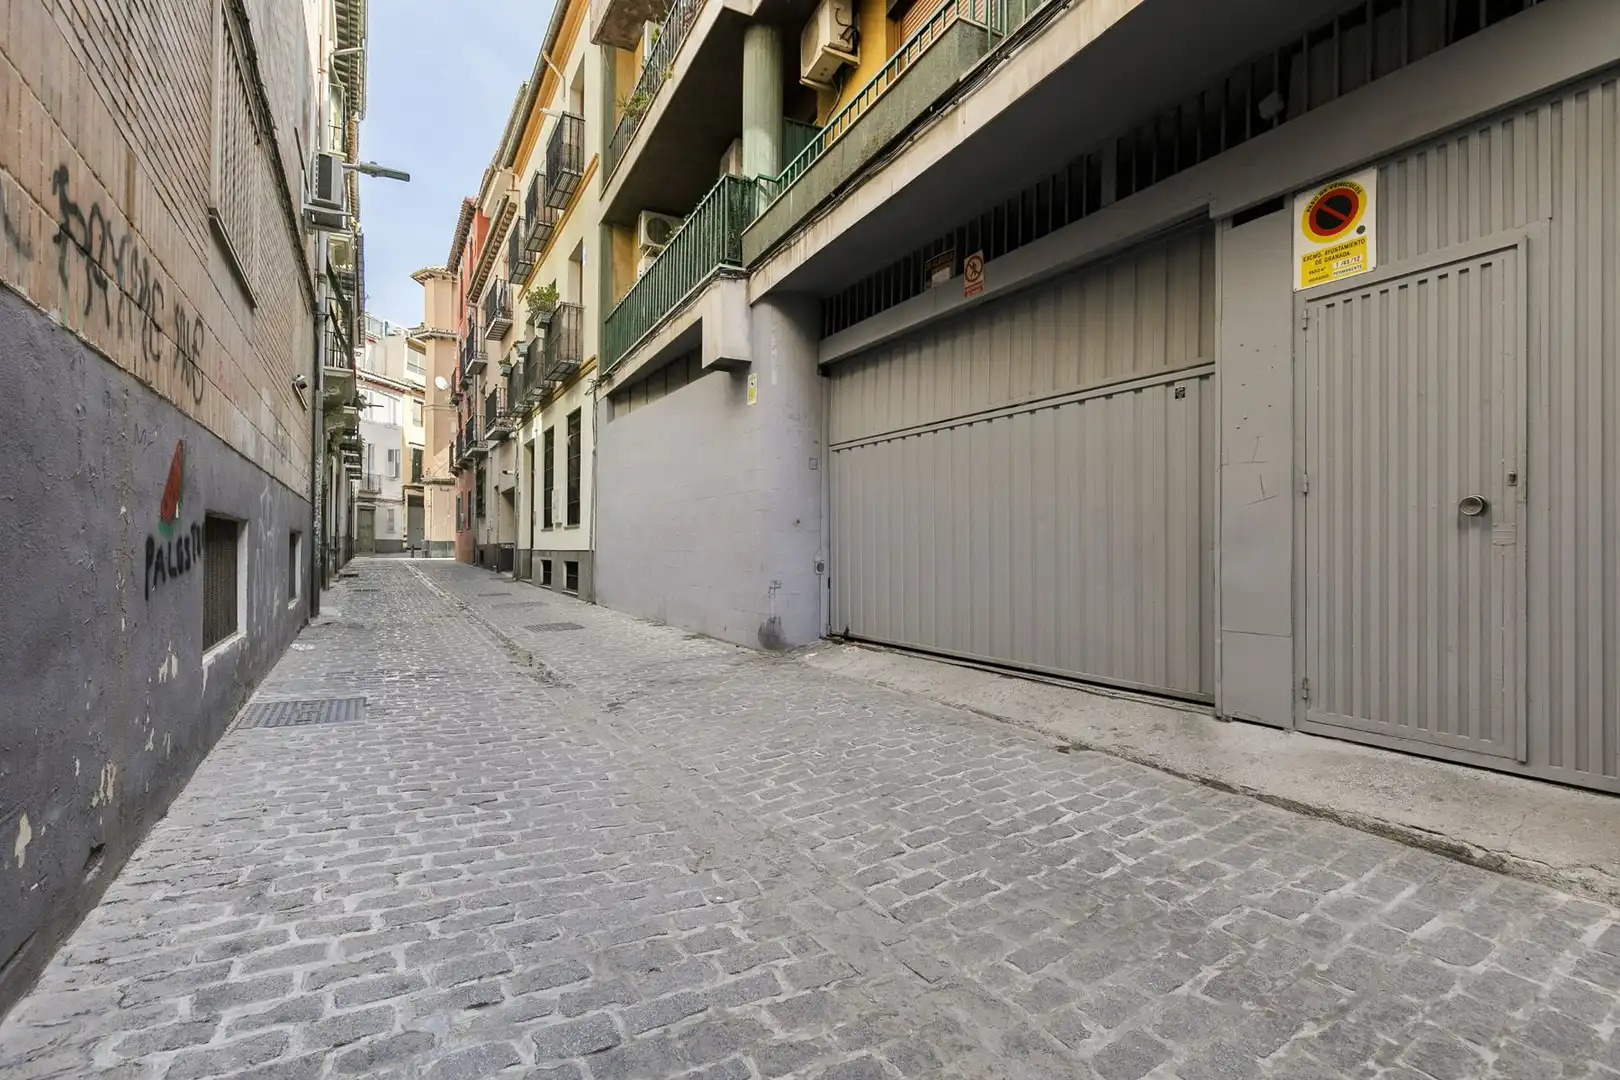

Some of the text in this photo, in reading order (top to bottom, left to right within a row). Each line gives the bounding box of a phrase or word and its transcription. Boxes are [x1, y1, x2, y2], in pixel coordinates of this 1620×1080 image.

[1325, 238, 1366, 256] AYUNTAMIENTO
[1315, 251, 1350, 266] DE GRANADA
